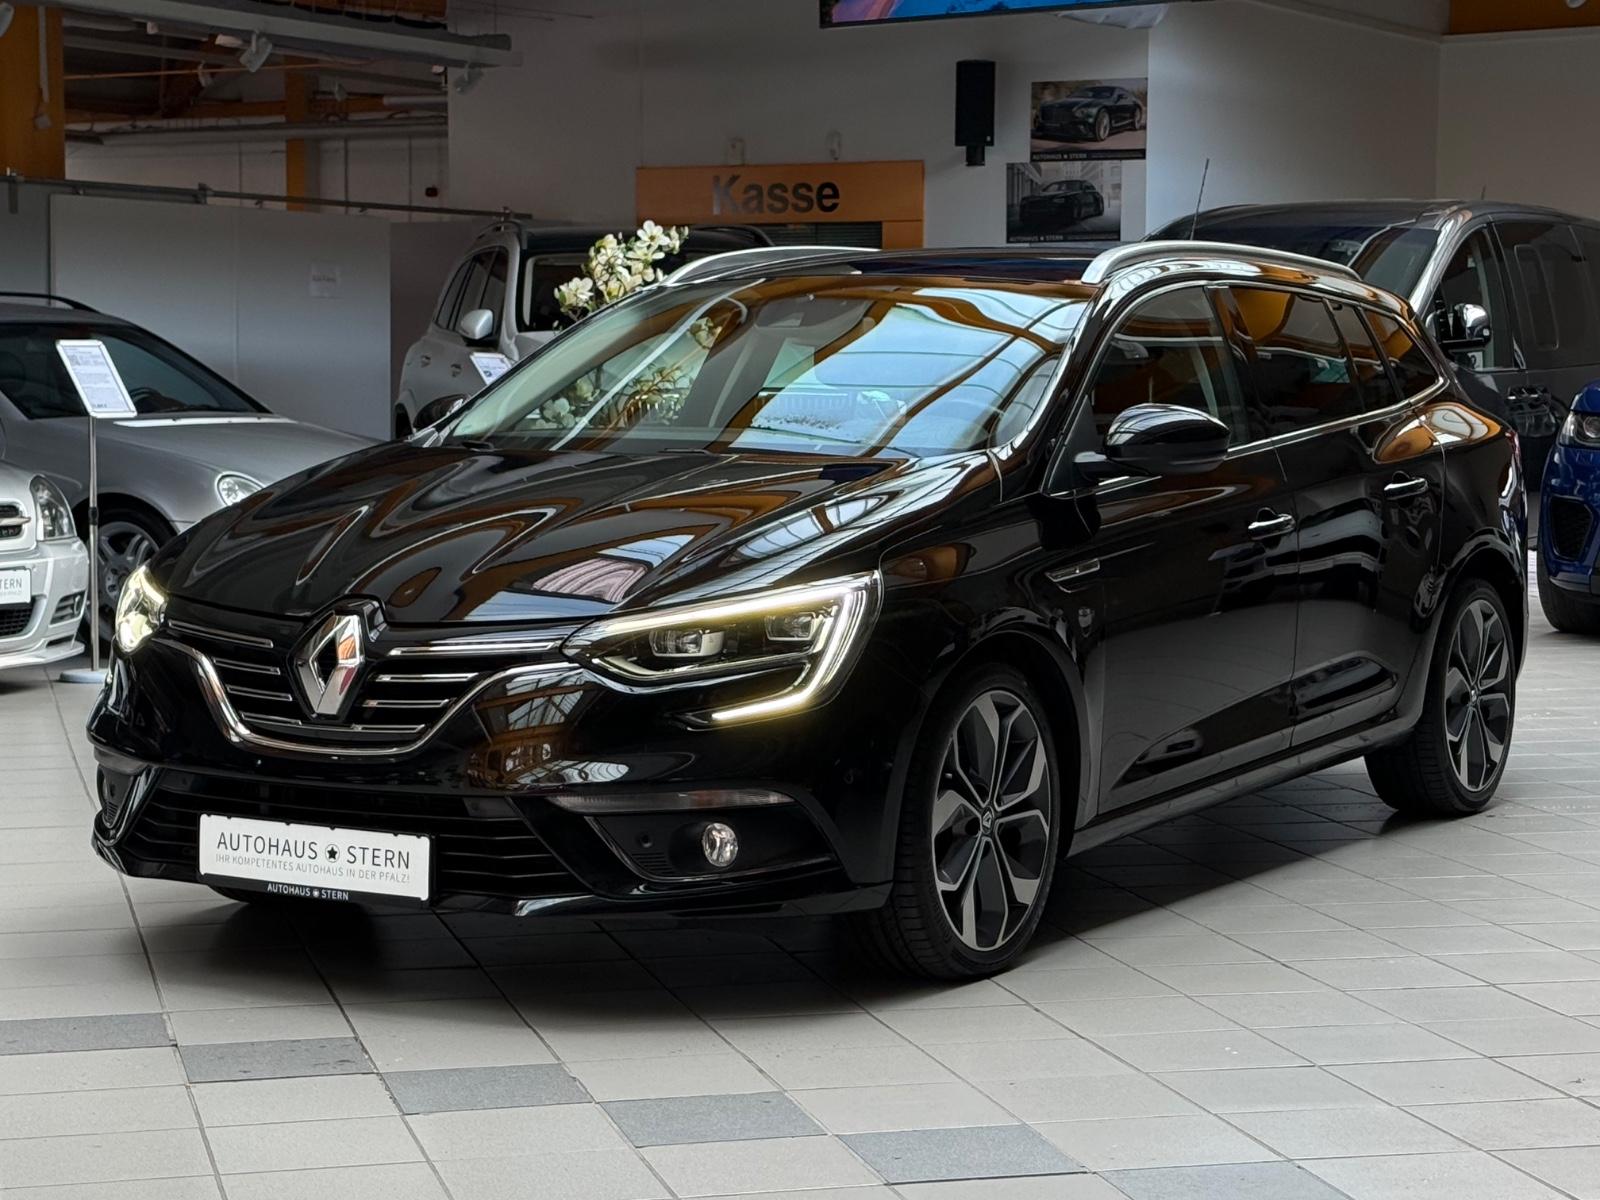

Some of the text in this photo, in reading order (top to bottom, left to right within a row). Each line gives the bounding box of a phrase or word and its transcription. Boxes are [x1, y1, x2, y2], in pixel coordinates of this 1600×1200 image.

[712, 174, 840, 215] Kasse
[217, 832, 410, 869] AUTOHAUS STERN
[216, 854, 231, 863] IHR
[232, 856, 294, 872] KOMPETENTES
[295, 863, 344, 876] AUTOHAUS
[346, 869, 356, 878] IN
[359, 870, 377, 880] DER
[267, 883, 349, 901] AUTOHAUS STERN
